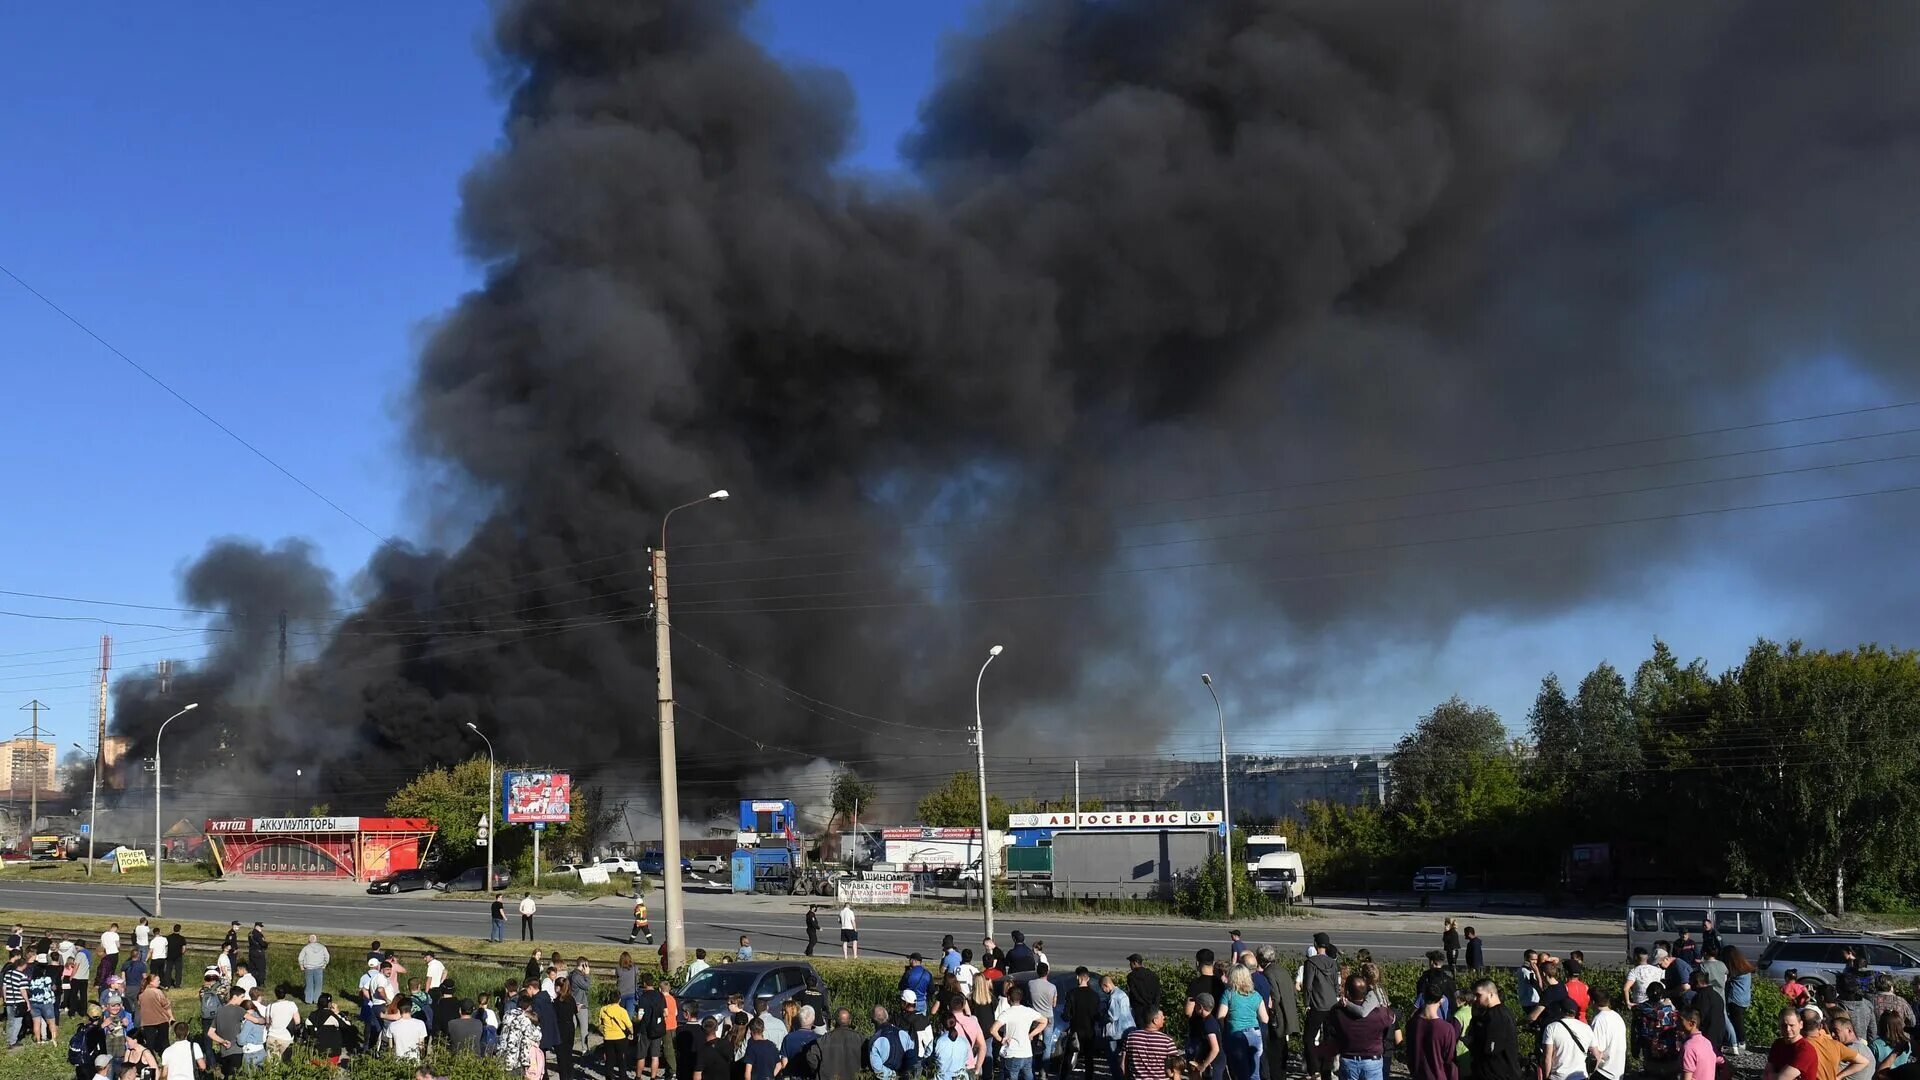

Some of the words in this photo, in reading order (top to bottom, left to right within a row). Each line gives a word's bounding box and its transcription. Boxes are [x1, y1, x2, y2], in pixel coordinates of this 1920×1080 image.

[259, 818, 336, 831] АККУМУЛЯТОРЫ
[1050, 814, 1179, 825] АВТОСЕРВИС
[118, 850, 145, 859] ПРИЕМ
[120, 857, 146, 866] ЛОМА
